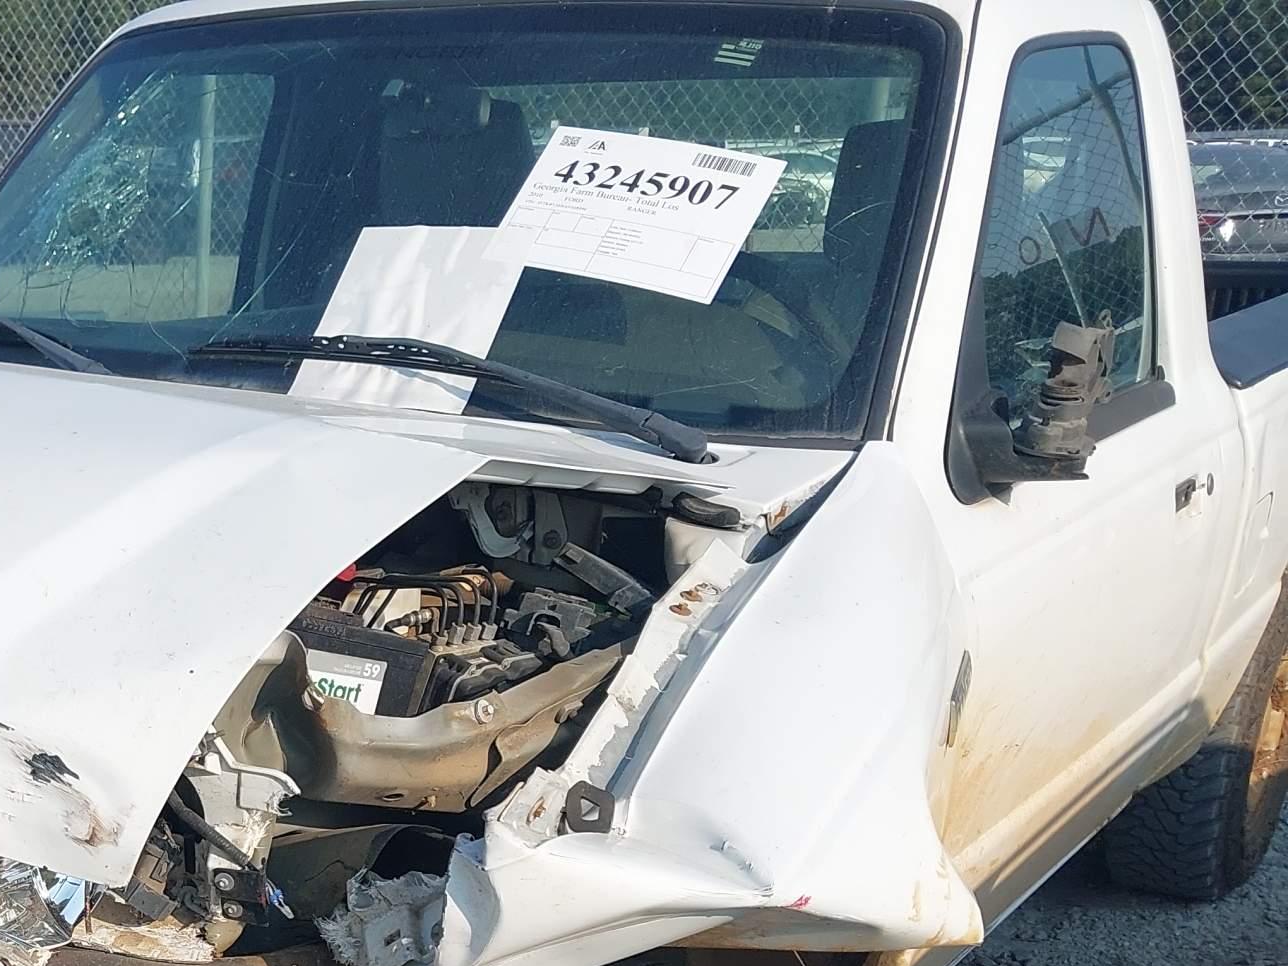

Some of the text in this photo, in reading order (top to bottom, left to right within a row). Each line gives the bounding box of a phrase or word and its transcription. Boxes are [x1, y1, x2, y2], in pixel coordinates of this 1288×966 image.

[532, 181, 569, 194] Georgia
[570, 186, 594, 197] Farm
[636, 197, 663, 209] Total
[553, 159, 741, 210] 43245907
[626, 205, 657, 216] RANGER
[362, 662, 381, 679] 59
[315, 677, 362, 703] Start
